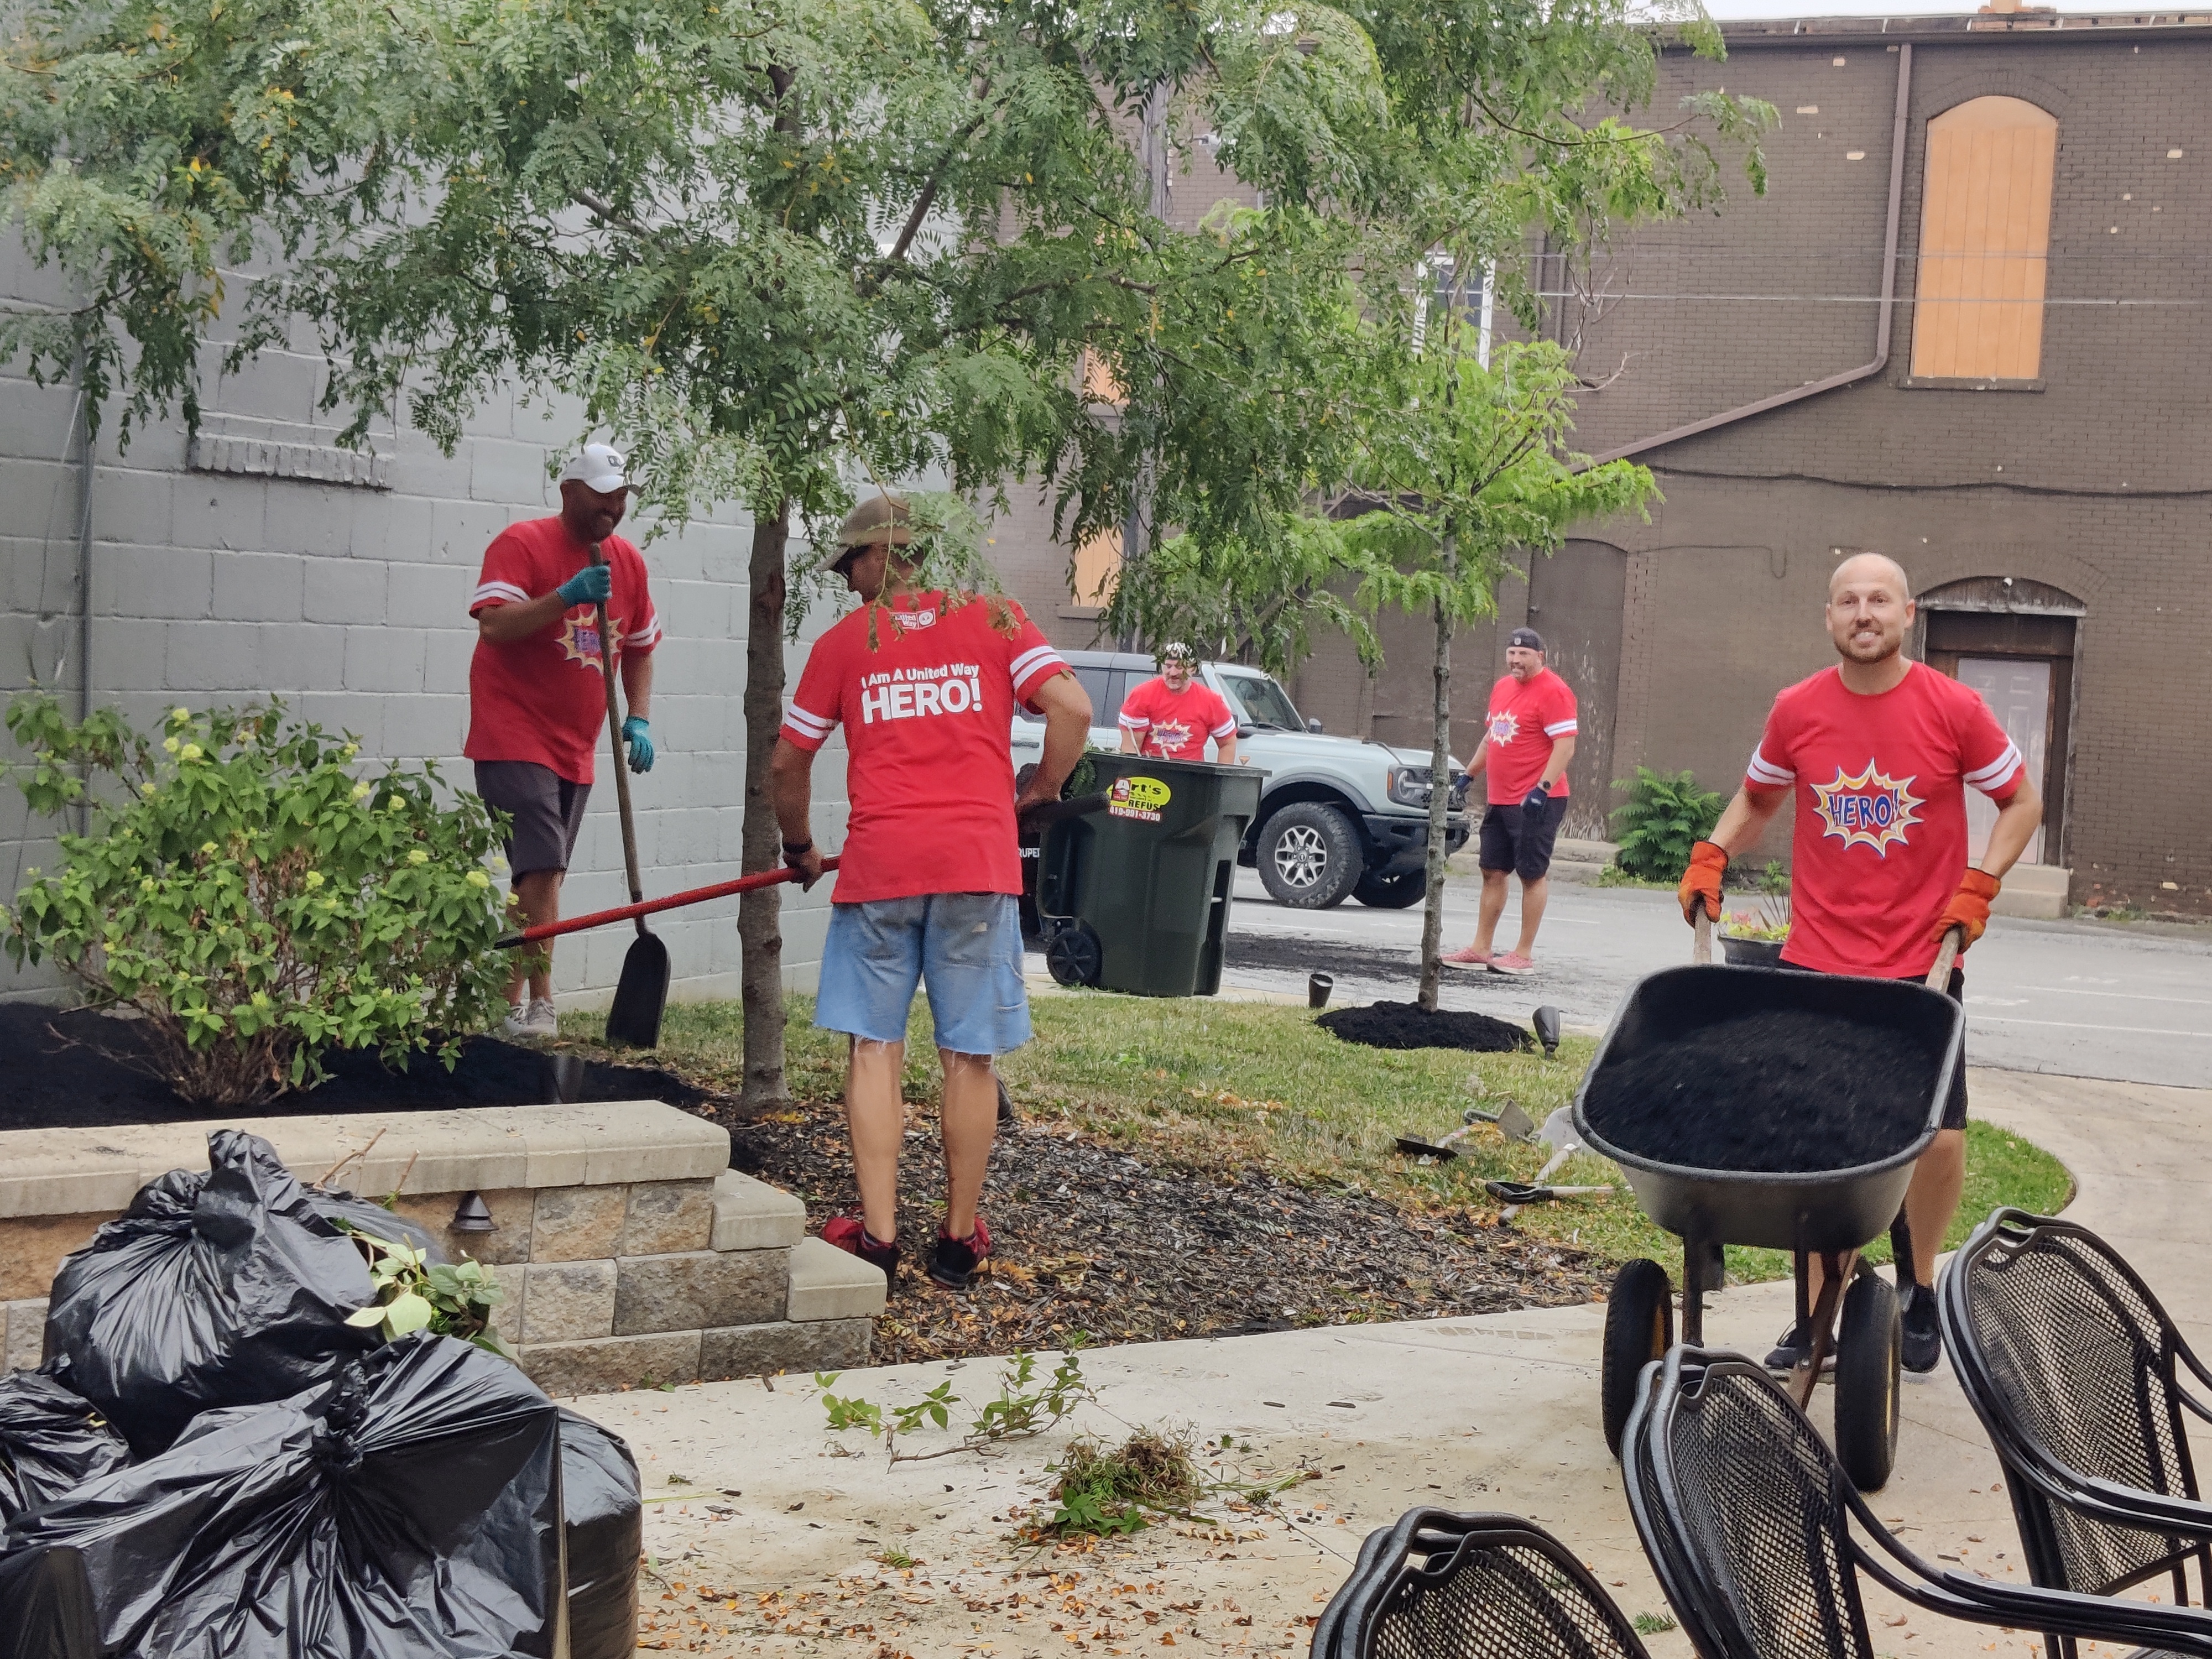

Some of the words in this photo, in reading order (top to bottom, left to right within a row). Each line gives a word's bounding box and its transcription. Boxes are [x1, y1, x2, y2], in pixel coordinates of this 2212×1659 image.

[861, 676, 867, 689] I
[868, 672, 890, 686] Am
[893, 669, 904, 681] A
[906, 664, 948, 681] United
[950, 662, 979, 678] Way
[861, 677, 983, 724] HERO!
[1827, 787, 1900, 830] HERO!
